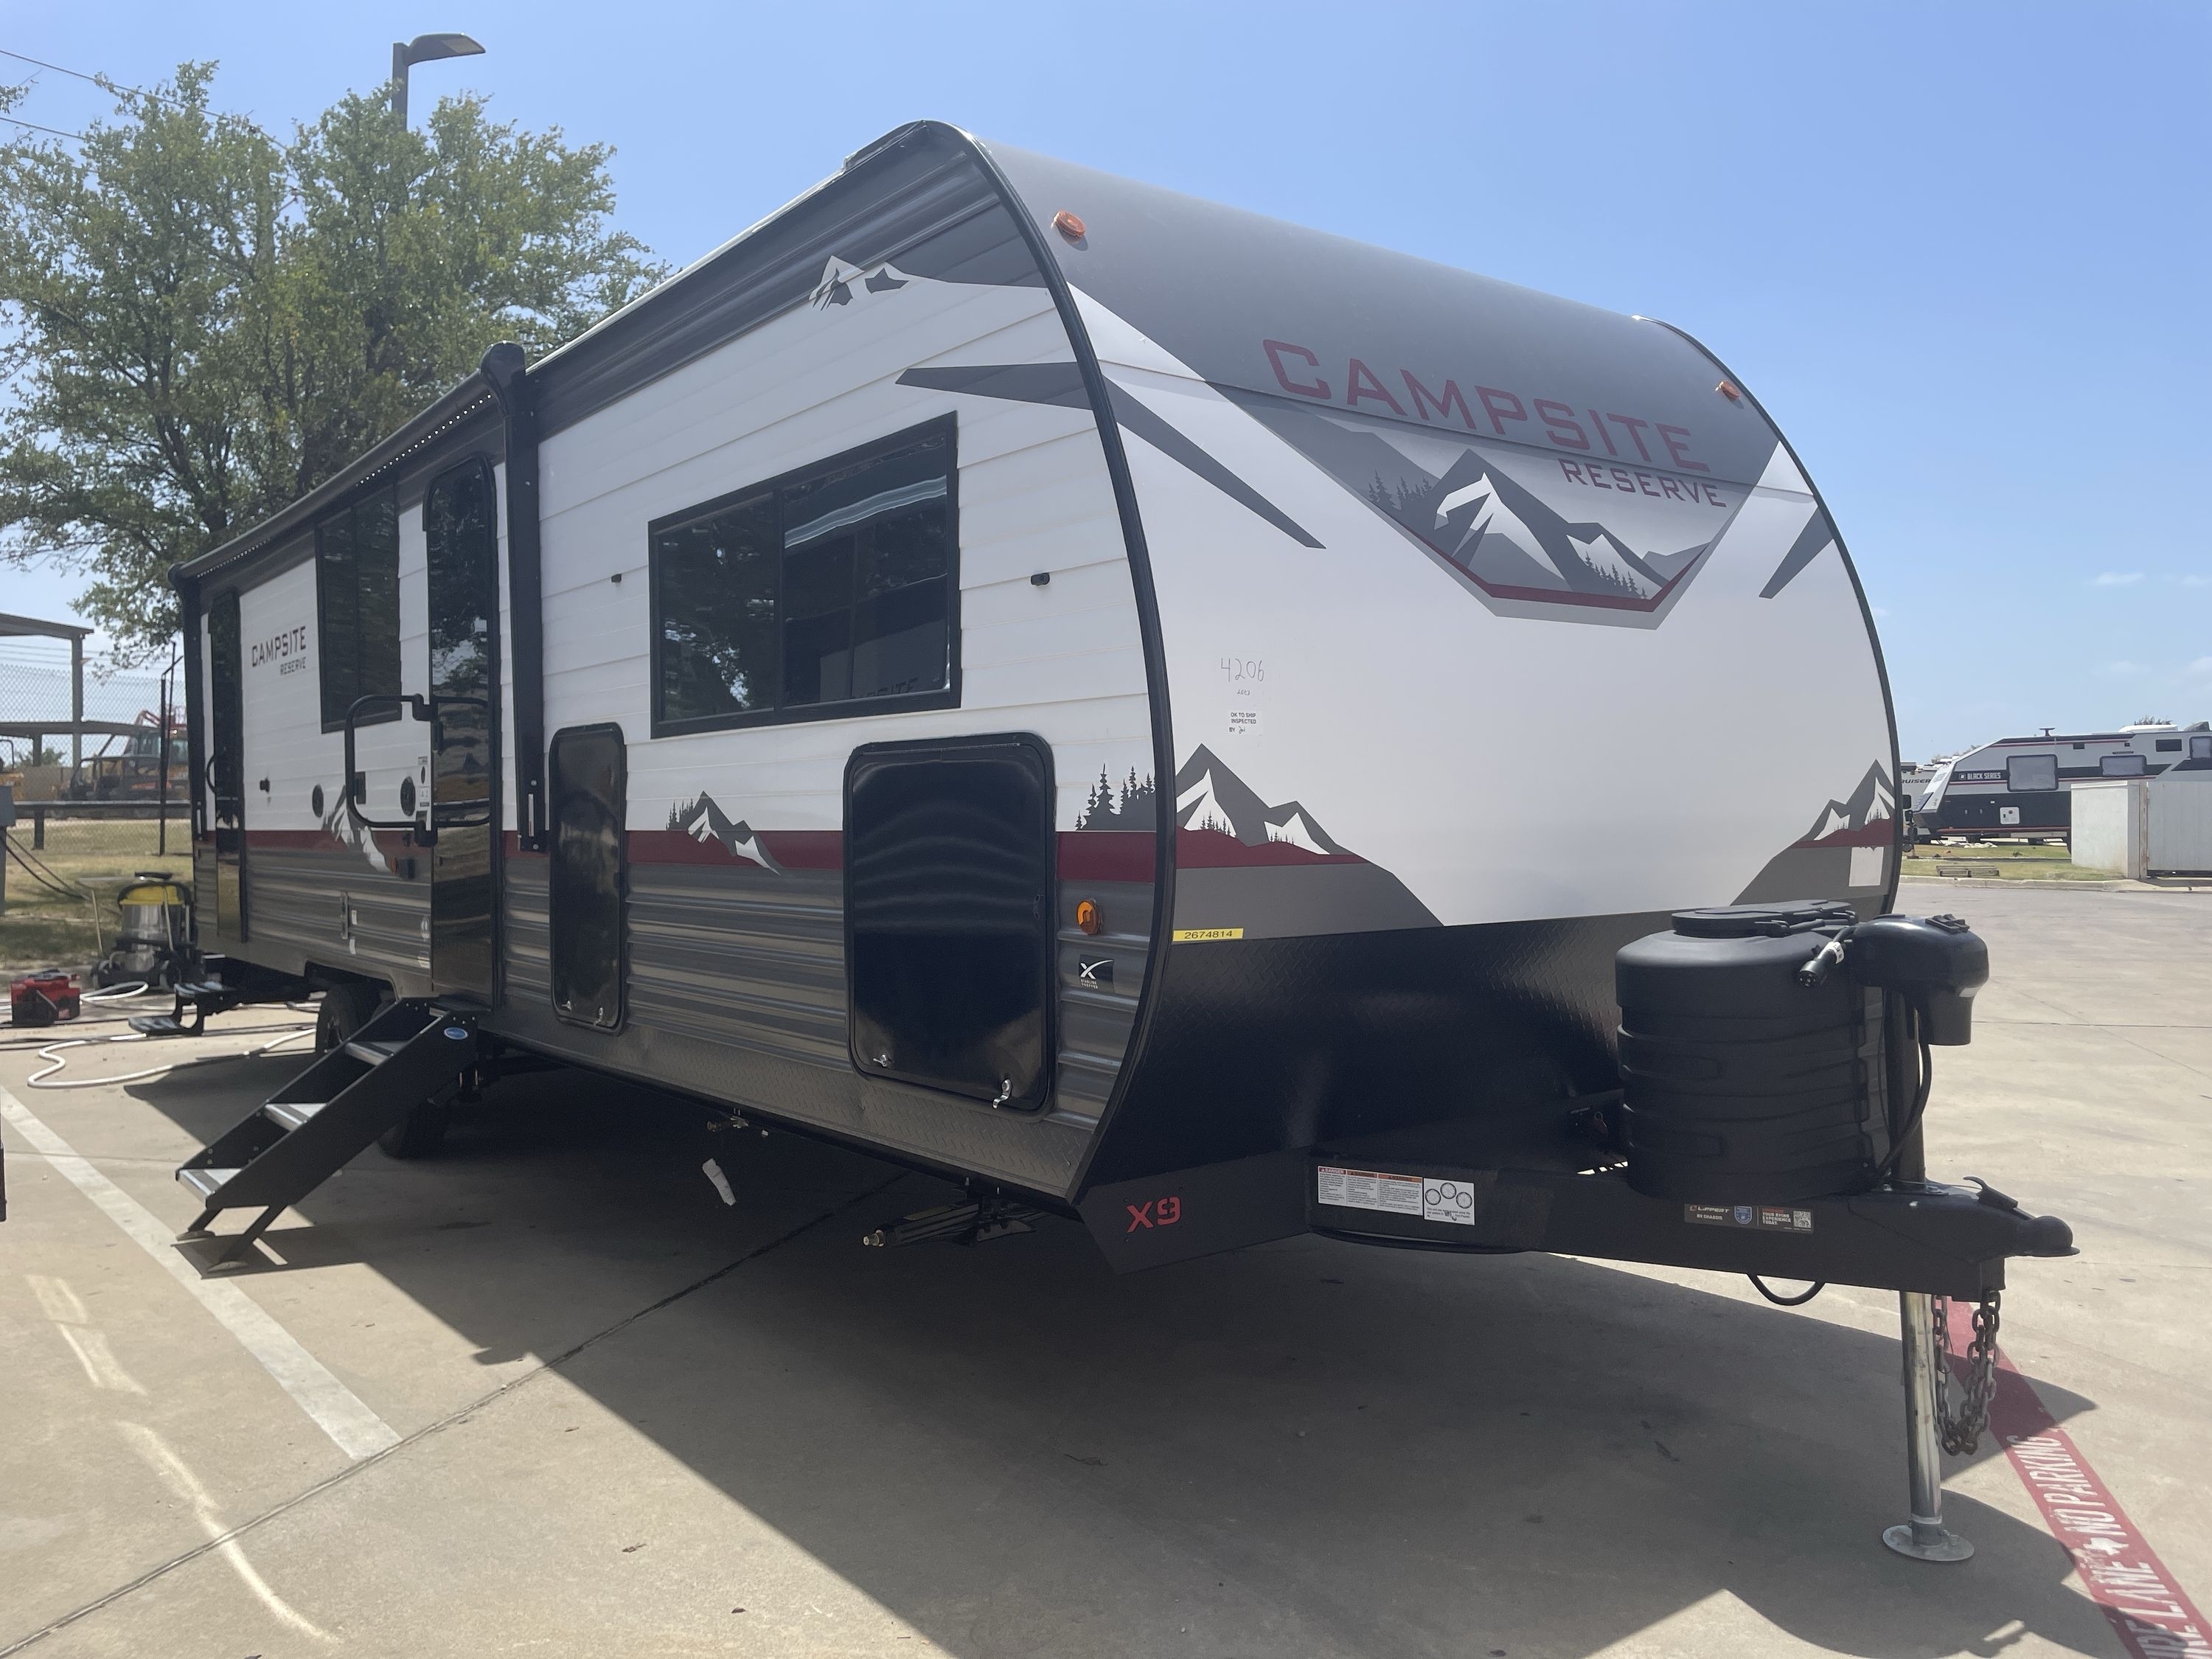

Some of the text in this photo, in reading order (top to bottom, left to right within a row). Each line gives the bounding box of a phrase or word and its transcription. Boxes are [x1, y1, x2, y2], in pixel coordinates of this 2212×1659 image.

[1262, 338, 1711, 473] CAMPSITE
[1559, 458, 1728, 509] RESERVE
[251, 625, 307, 667] CAMPSITE
[280, 656, 307, 675] RESERVE
[1220, 657, 1265, 683] 4206
[1183, 930, 1234, 939] 2674814
[1126, 1196, 1181, 1234] X9
[2006, 1434, 2106, 1506] PARKING
[2051, 1508, 2128, 1537] NO
[2090, 1561, 2188, 1618] LANE
